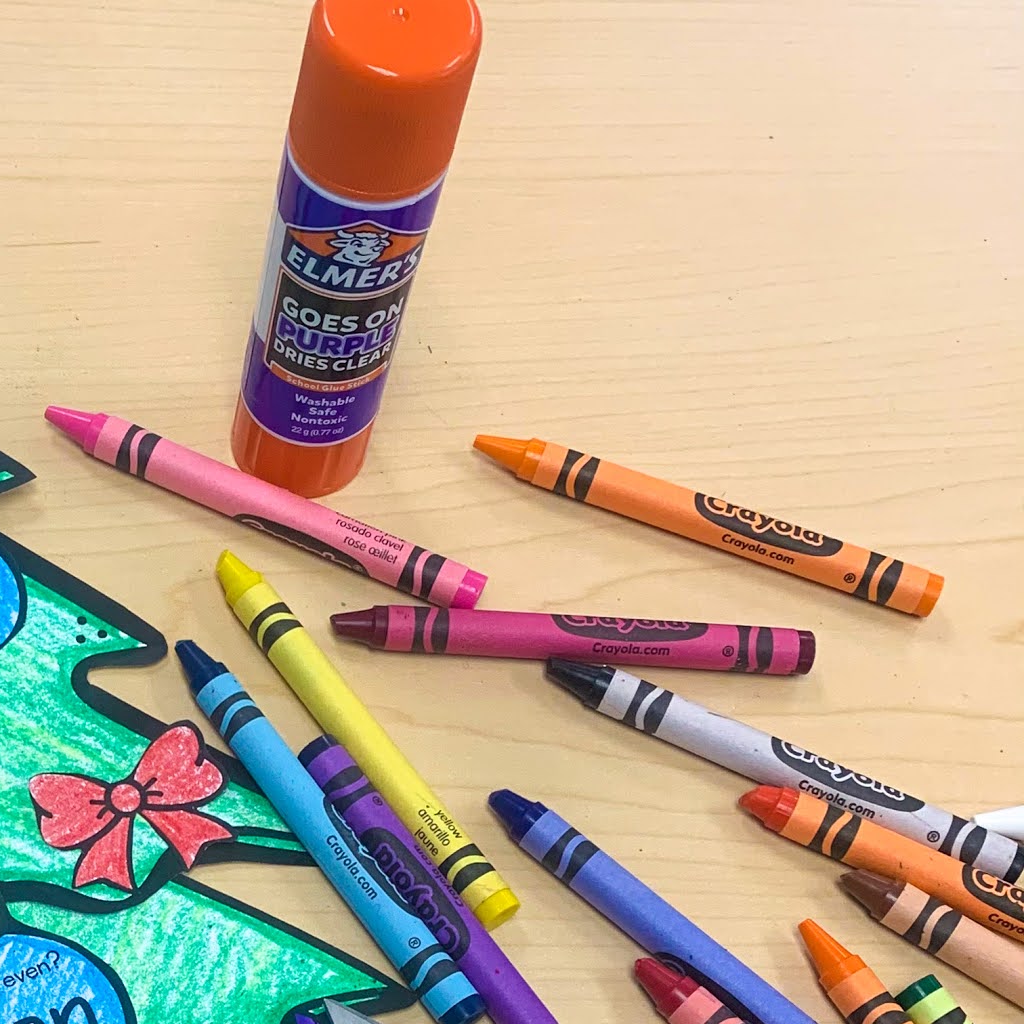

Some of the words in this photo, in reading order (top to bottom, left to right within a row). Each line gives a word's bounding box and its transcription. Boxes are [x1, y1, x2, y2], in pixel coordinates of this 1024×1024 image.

[286, 244, 422, 288] ELMER'S
[283, 296, 359, 333] GOES
[365, 297, 404, 325] ON
[276, 311, 400, 358] PURPLE
[274, 338, 329, 371] DRIES
[332, 343, 391, 372] CLEAR
[286, 375, 319, 391] School
[322, 383, 345, 392] Glue
[347, 377, 370, 390] Stick
[295, 393, 355, 407] Washable
[309, 407, 337, 416] Safe
[291, 412, 348, 425] Nontoxic
[291, 426, 302, 434] 22
[336, 517, 372, 538] rosado
[374, 531, 404, 552] clavel
[704, 495, 824, 547] Crayola
[343, 535, 367, 552] rose
[721, 534, 795, 565] Crayola.com
[592, 642, 670, 656] Crayola.com
[798, 779, 876, 820] Crayola.com
[417, 808, 451, 848] amarillo
[434, 809, 463, 840] yellow
[414, 827, 439, 857] jaune
[326, 834, 378, 900] Crayola.com
[3, 950, 60, 987] even?
